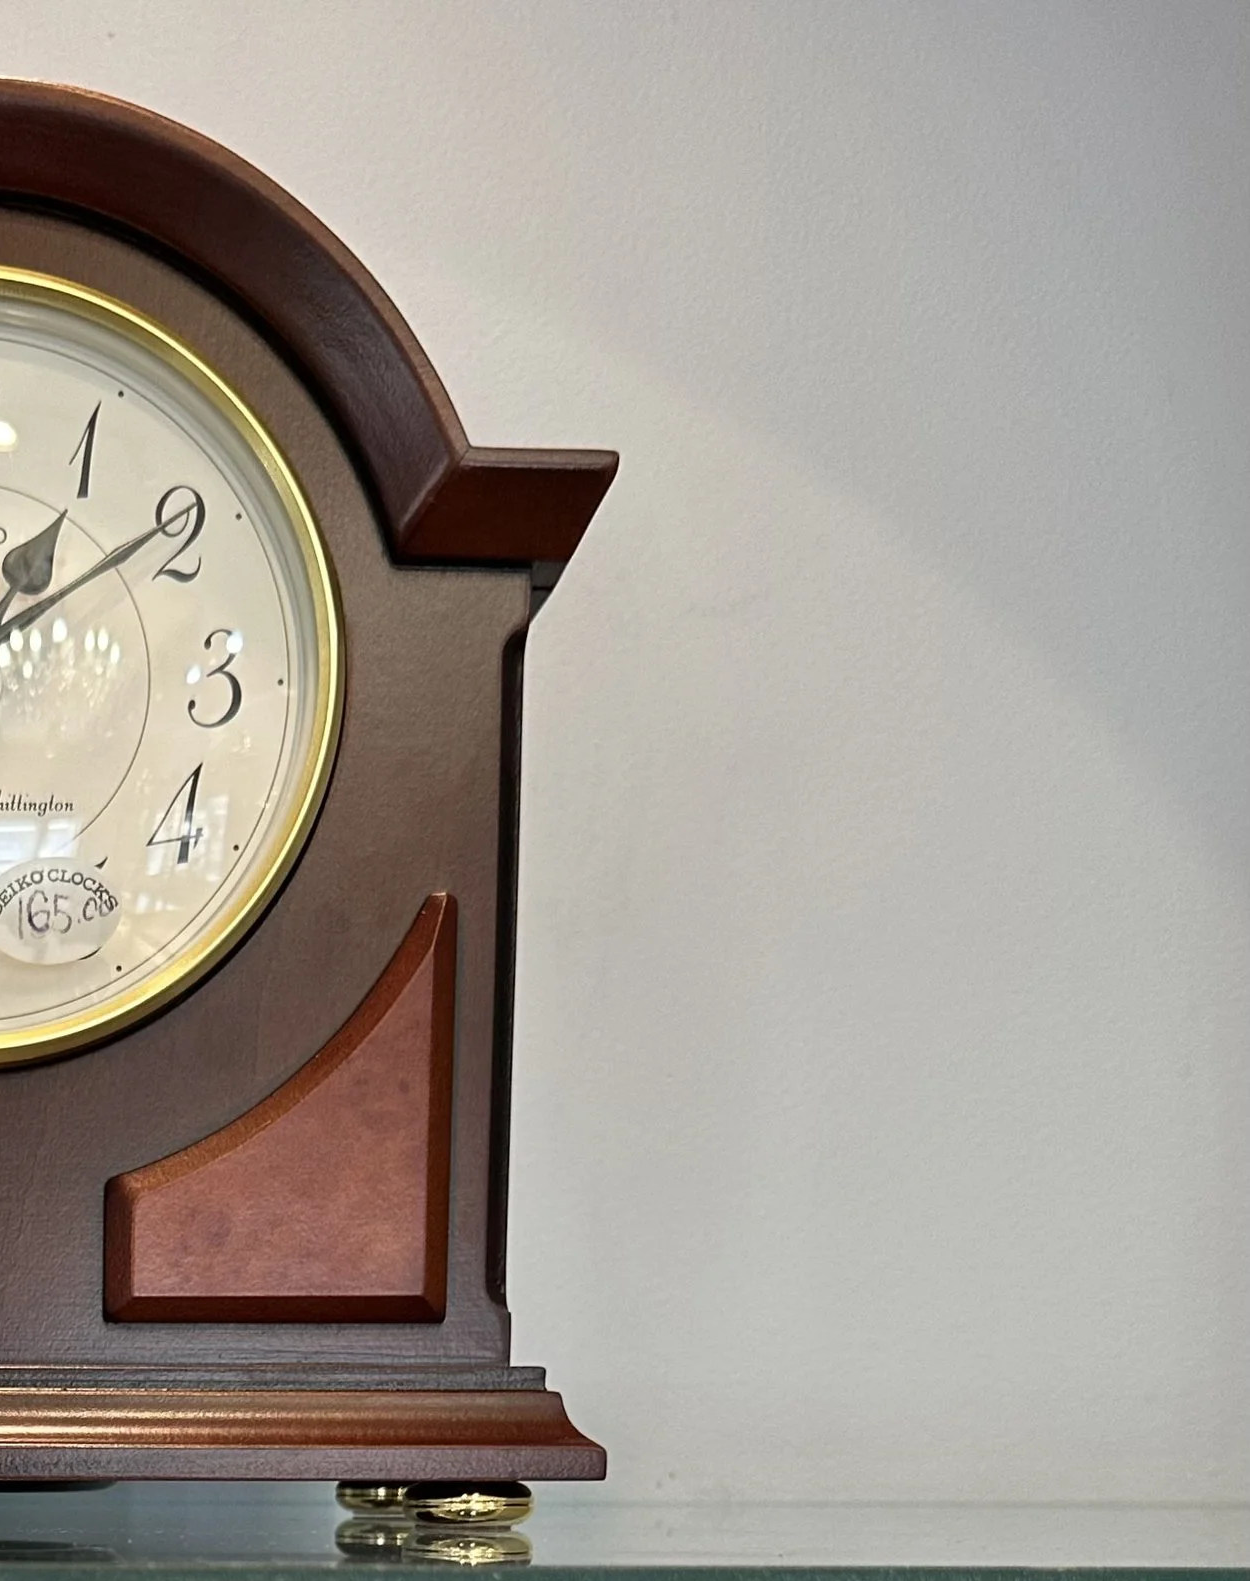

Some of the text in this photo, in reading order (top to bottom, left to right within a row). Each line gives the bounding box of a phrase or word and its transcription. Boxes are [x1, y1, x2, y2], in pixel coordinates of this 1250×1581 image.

[69, 400, 101, 499] 1
[152, 485, 206, 583] 2
[187, 629, 243, 729] 3
[145, 762, 204, 865] 4
[47, 868, 118, 913] CLOCKS
